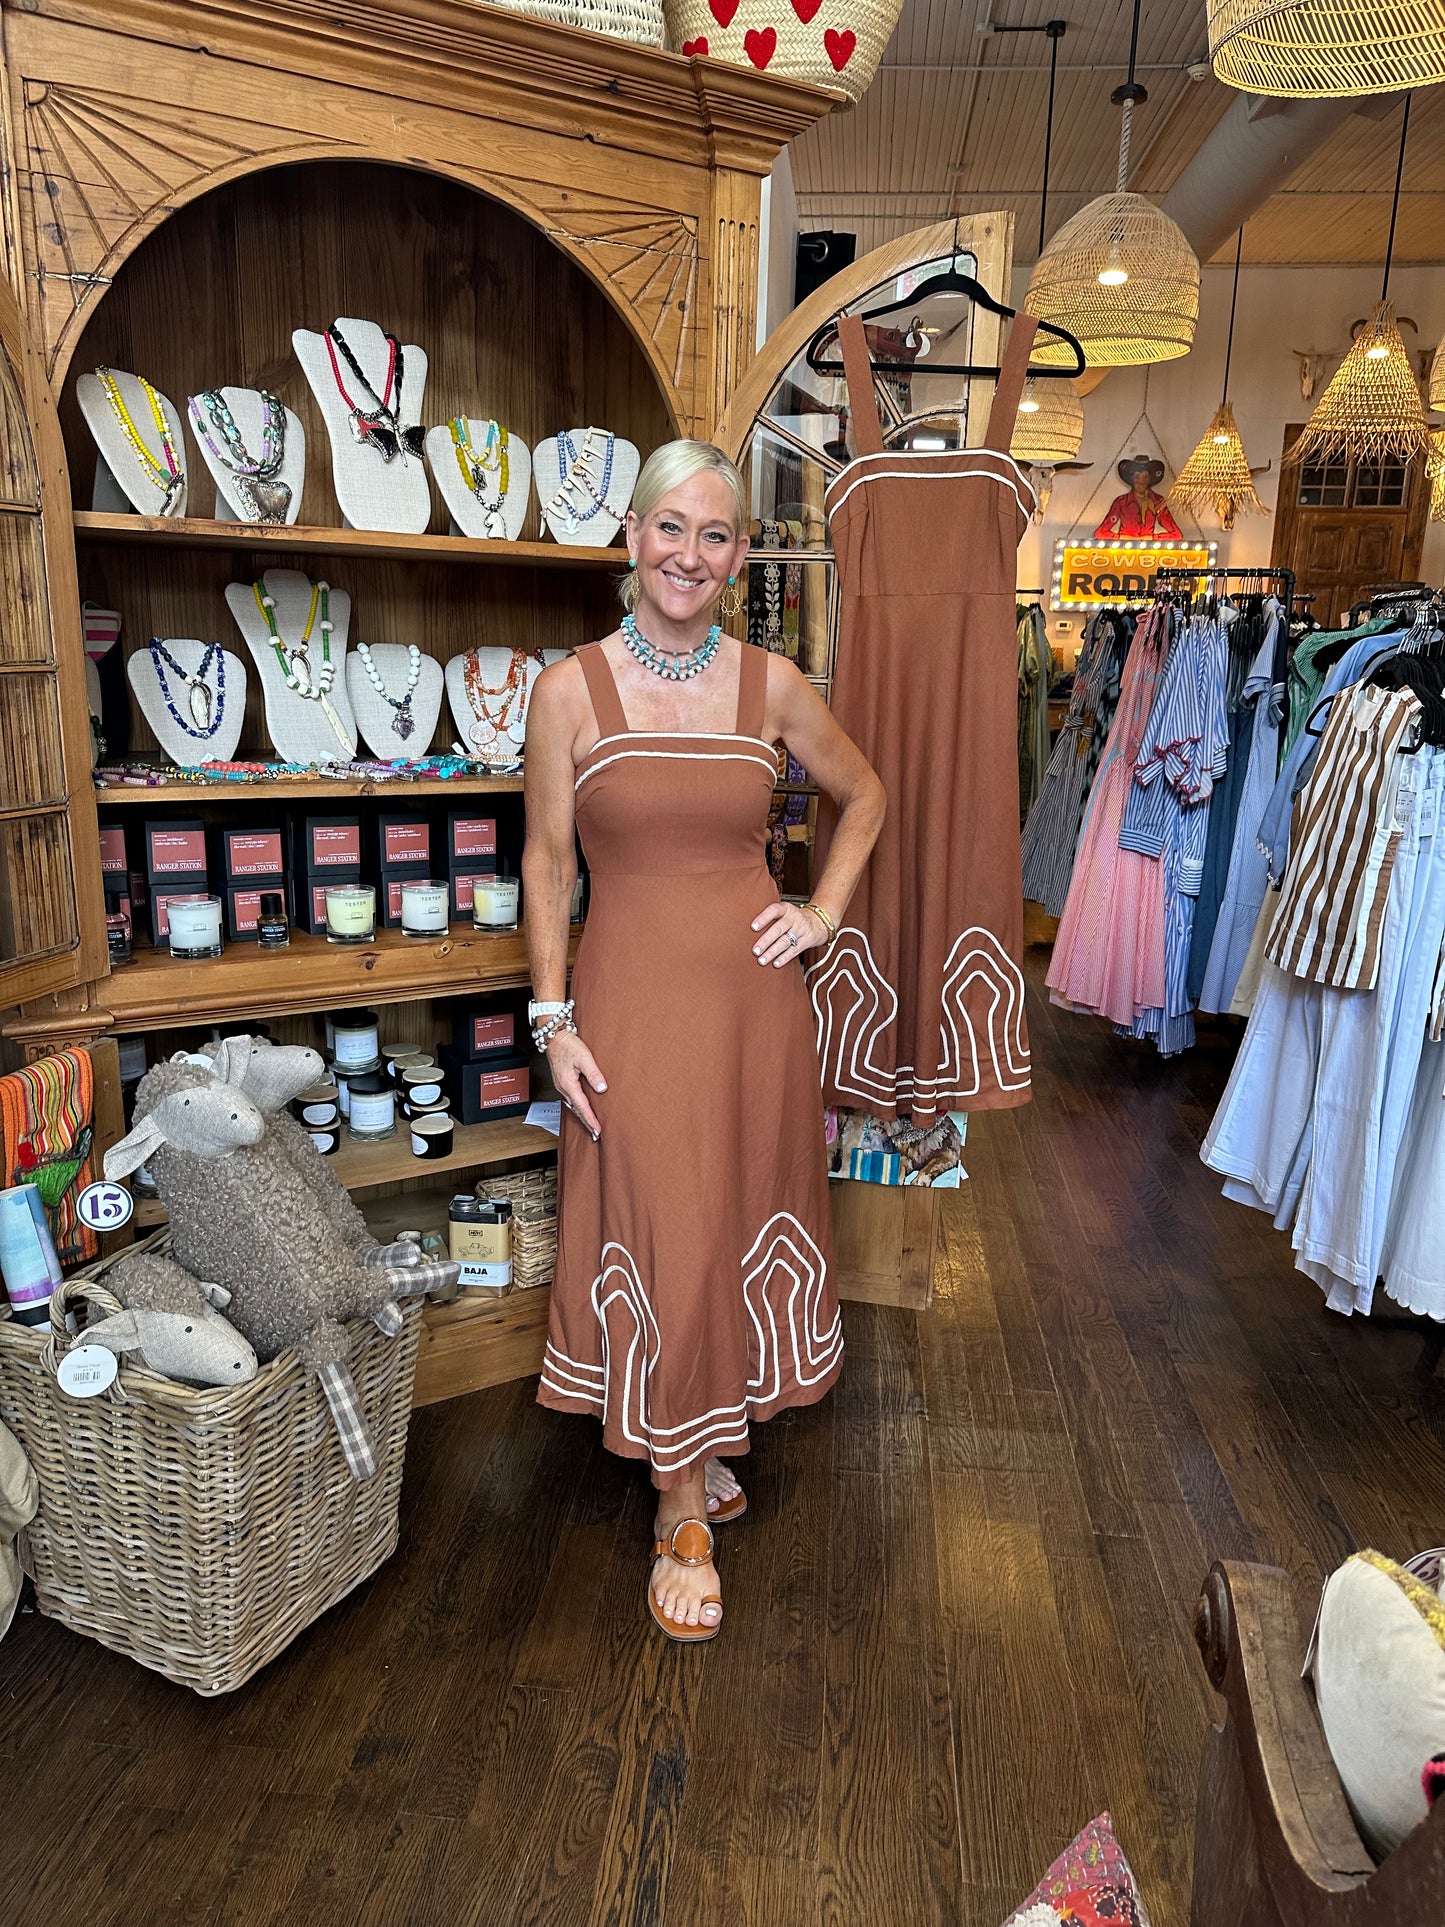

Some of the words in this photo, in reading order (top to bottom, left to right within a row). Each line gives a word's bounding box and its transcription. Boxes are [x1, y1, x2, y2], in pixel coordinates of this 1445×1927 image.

[1070, 554, 1201, 568] COWBOY
[316, 855, 337, 863] RANGER
[235, 865, 257, 873] RANGER
[257, 864, 279, 872] STATION
[240, 921, 258, 929] RANGE
[501, 1096, 520, 1104] STATION
[89, 1193, 122, 1219] 15
[464, 1267, 488, 1275] BAJA
